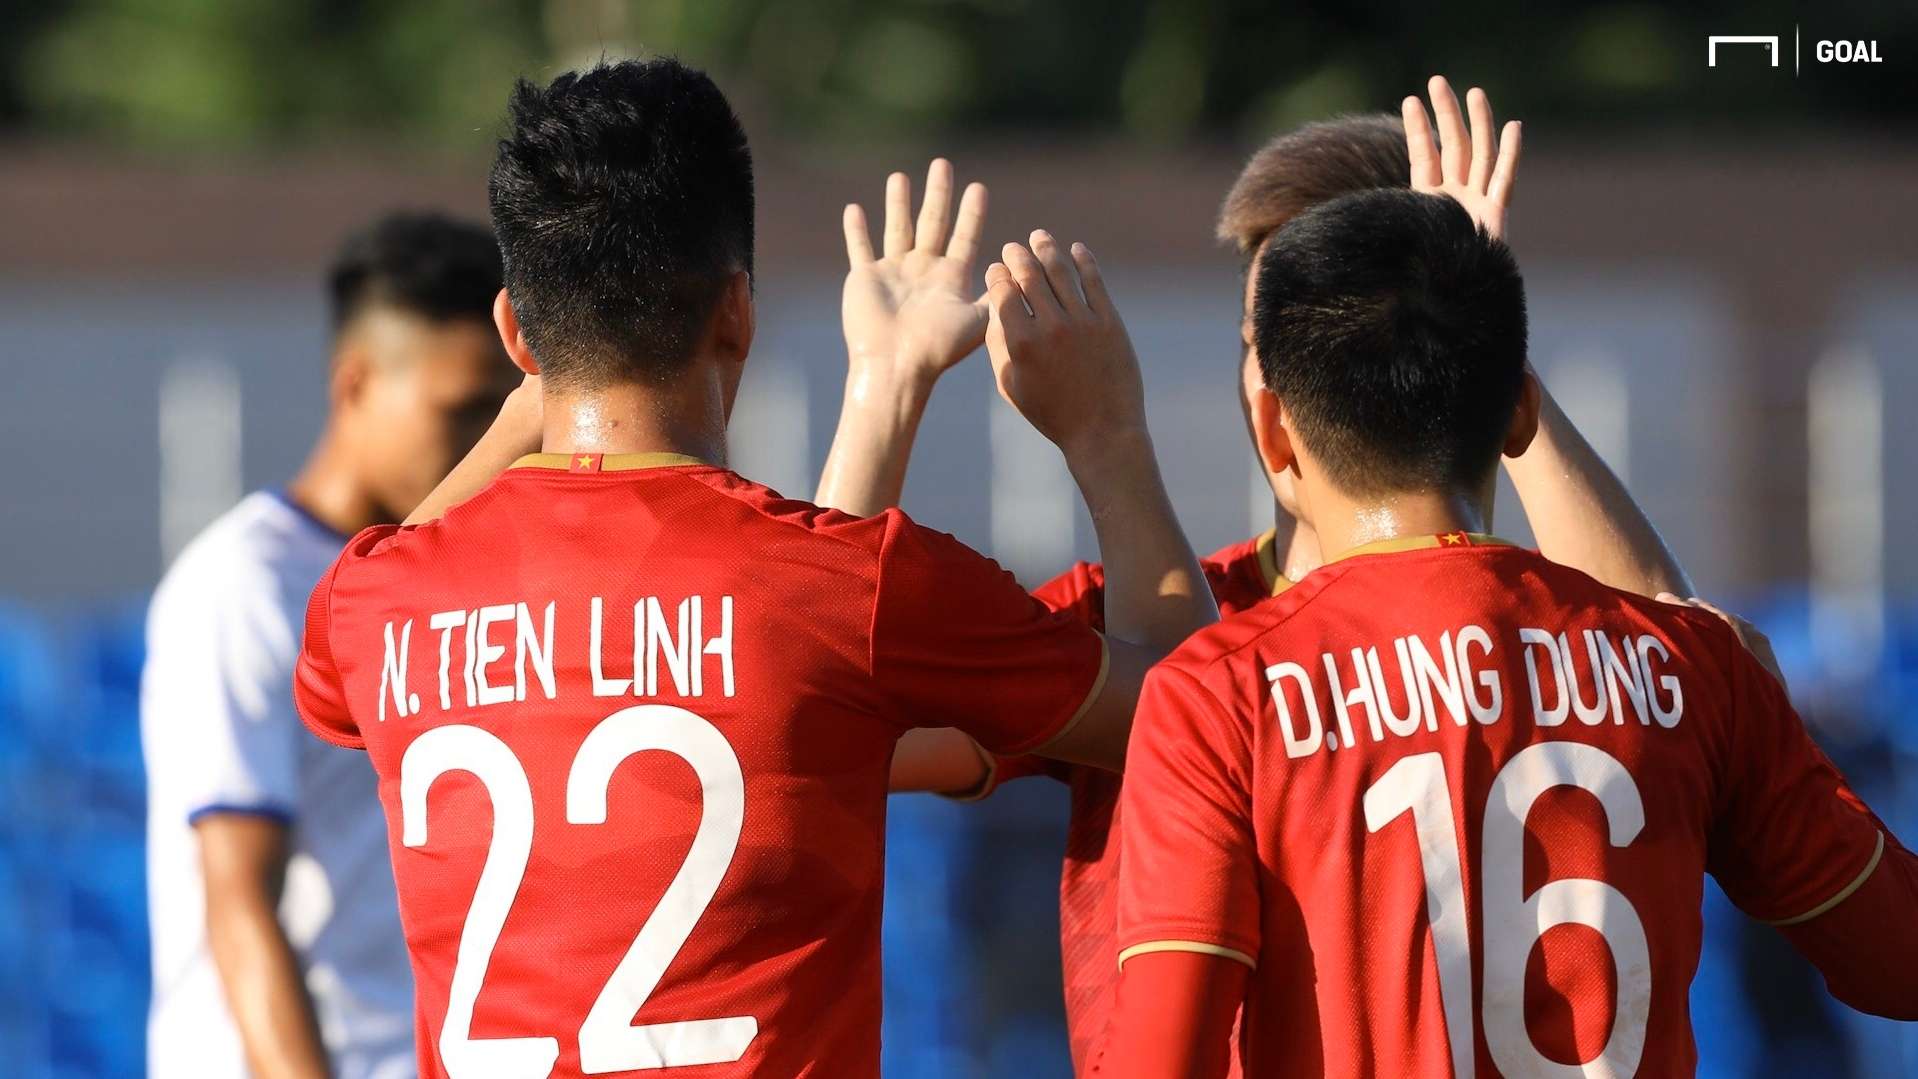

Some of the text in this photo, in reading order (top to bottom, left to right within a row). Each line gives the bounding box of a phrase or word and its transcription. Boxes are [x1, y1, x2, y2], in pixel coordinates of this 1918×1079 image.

[588, 595, 735, 698] LINH
[1265, 625, 1684, 759] D.HUNG DUNG
[400, 704, 759, 1079] 22
[1363, 740, 1652, 1079] 16
